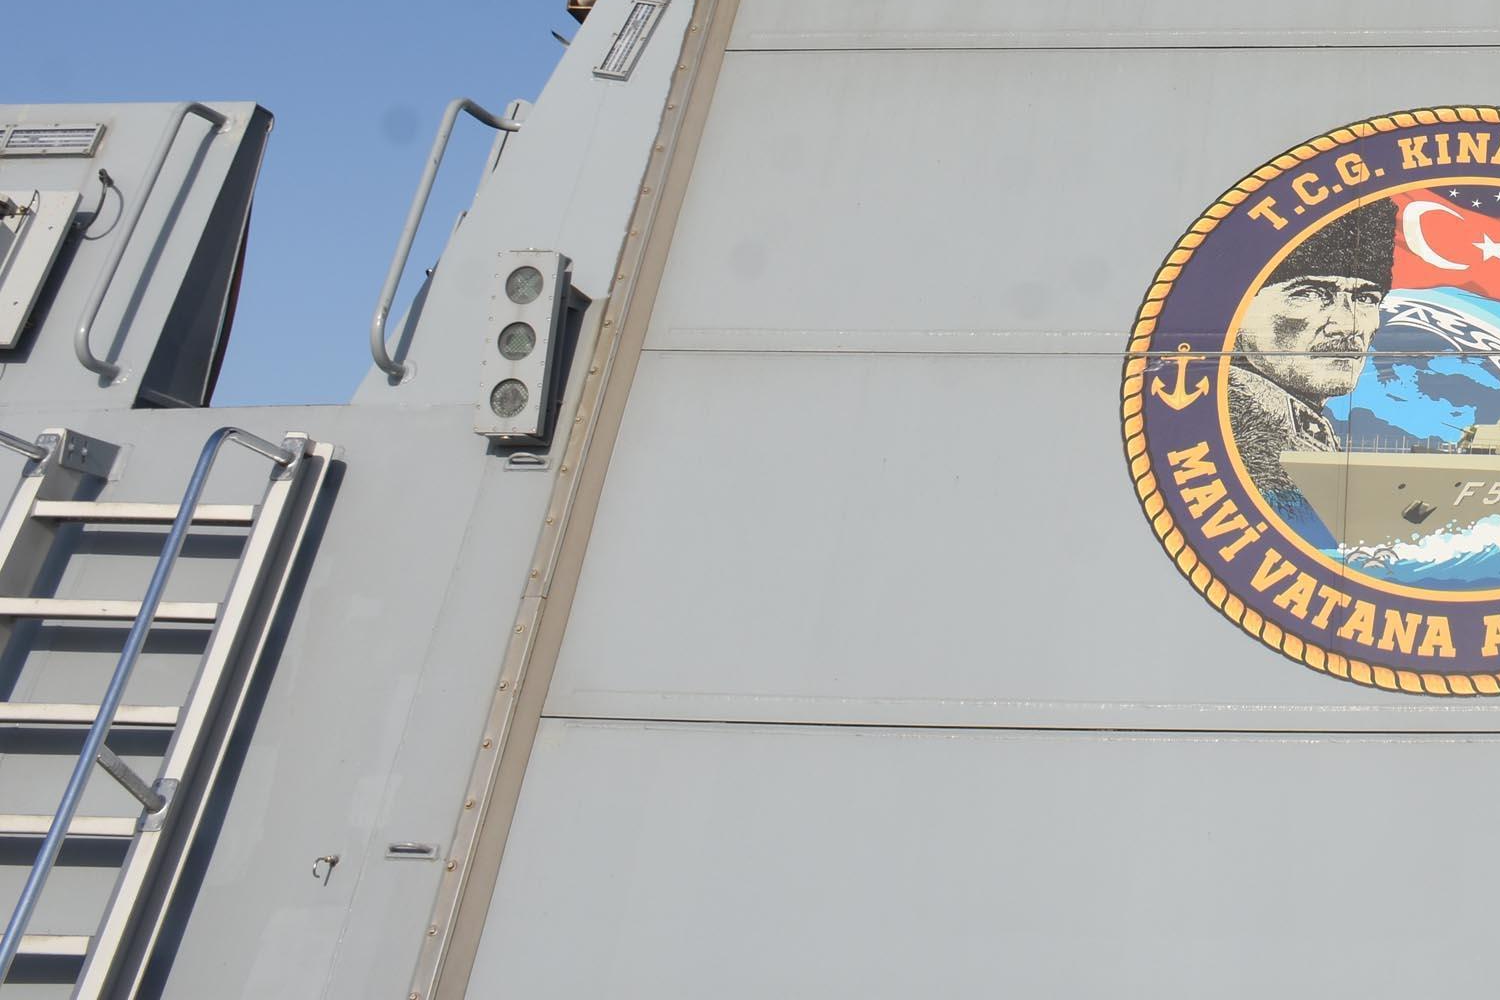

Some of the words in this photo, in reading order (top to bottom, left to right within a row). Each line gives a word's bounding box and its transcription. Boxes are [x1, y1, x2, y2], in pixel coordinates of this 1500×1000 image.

[1247, 152, 1385, 231] T.C.G.
[1453, 481, 1486, 506] F
[1167, 440, 1269, 563] MAVİ
[1250, 547, 1457, 658] VATANA
